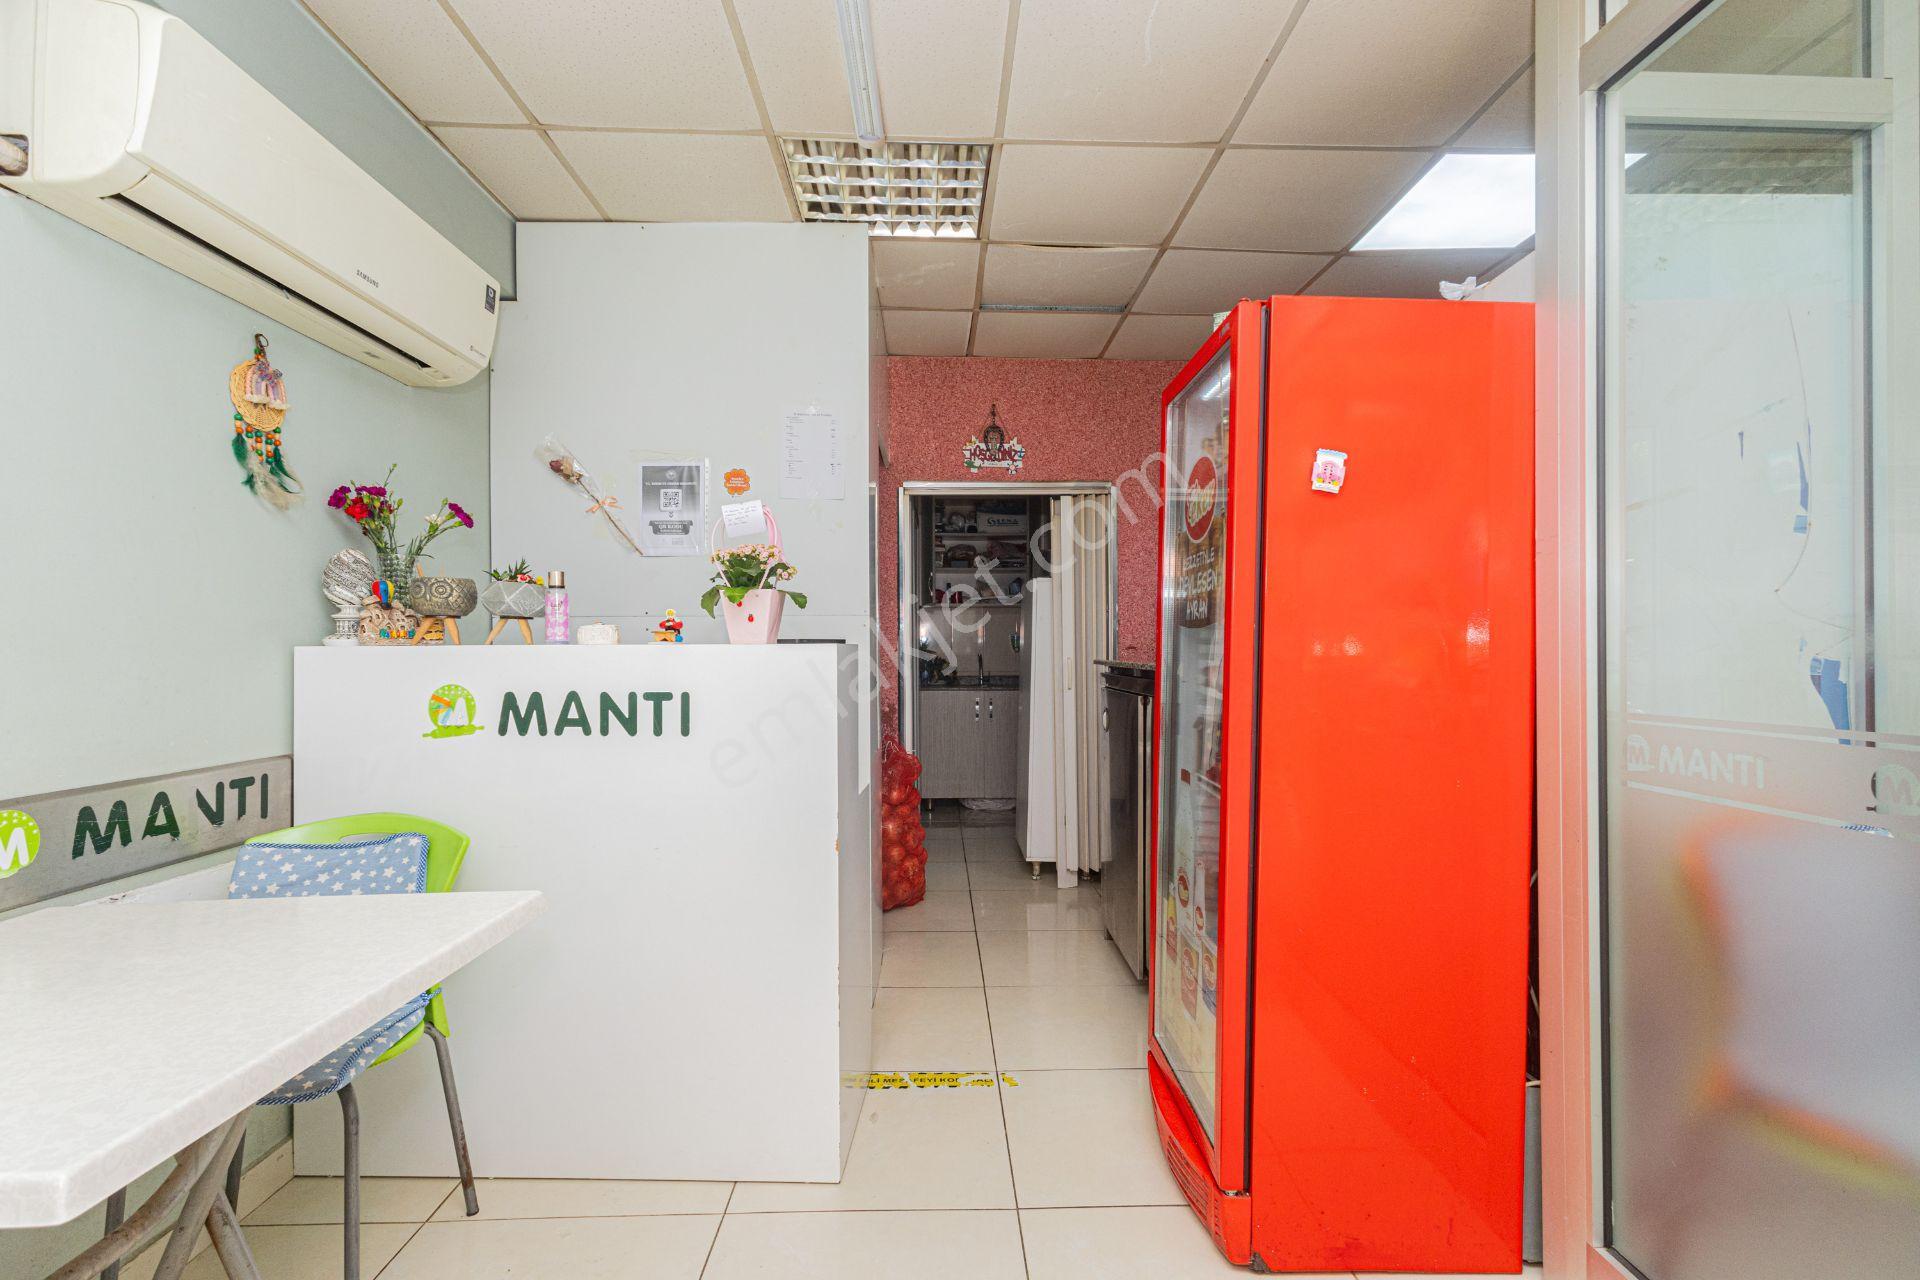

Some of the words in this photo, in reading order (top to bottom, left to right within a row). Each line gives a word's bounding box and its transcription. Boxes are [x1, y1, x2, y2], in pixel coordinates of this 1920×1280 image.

[357, 269, 379, 288] SAMSUNG
[498, 691, 691, 737] MANTI
[1658, 744, 1766, 790] MANTI
[71, 773, 269, 860] MANTI
